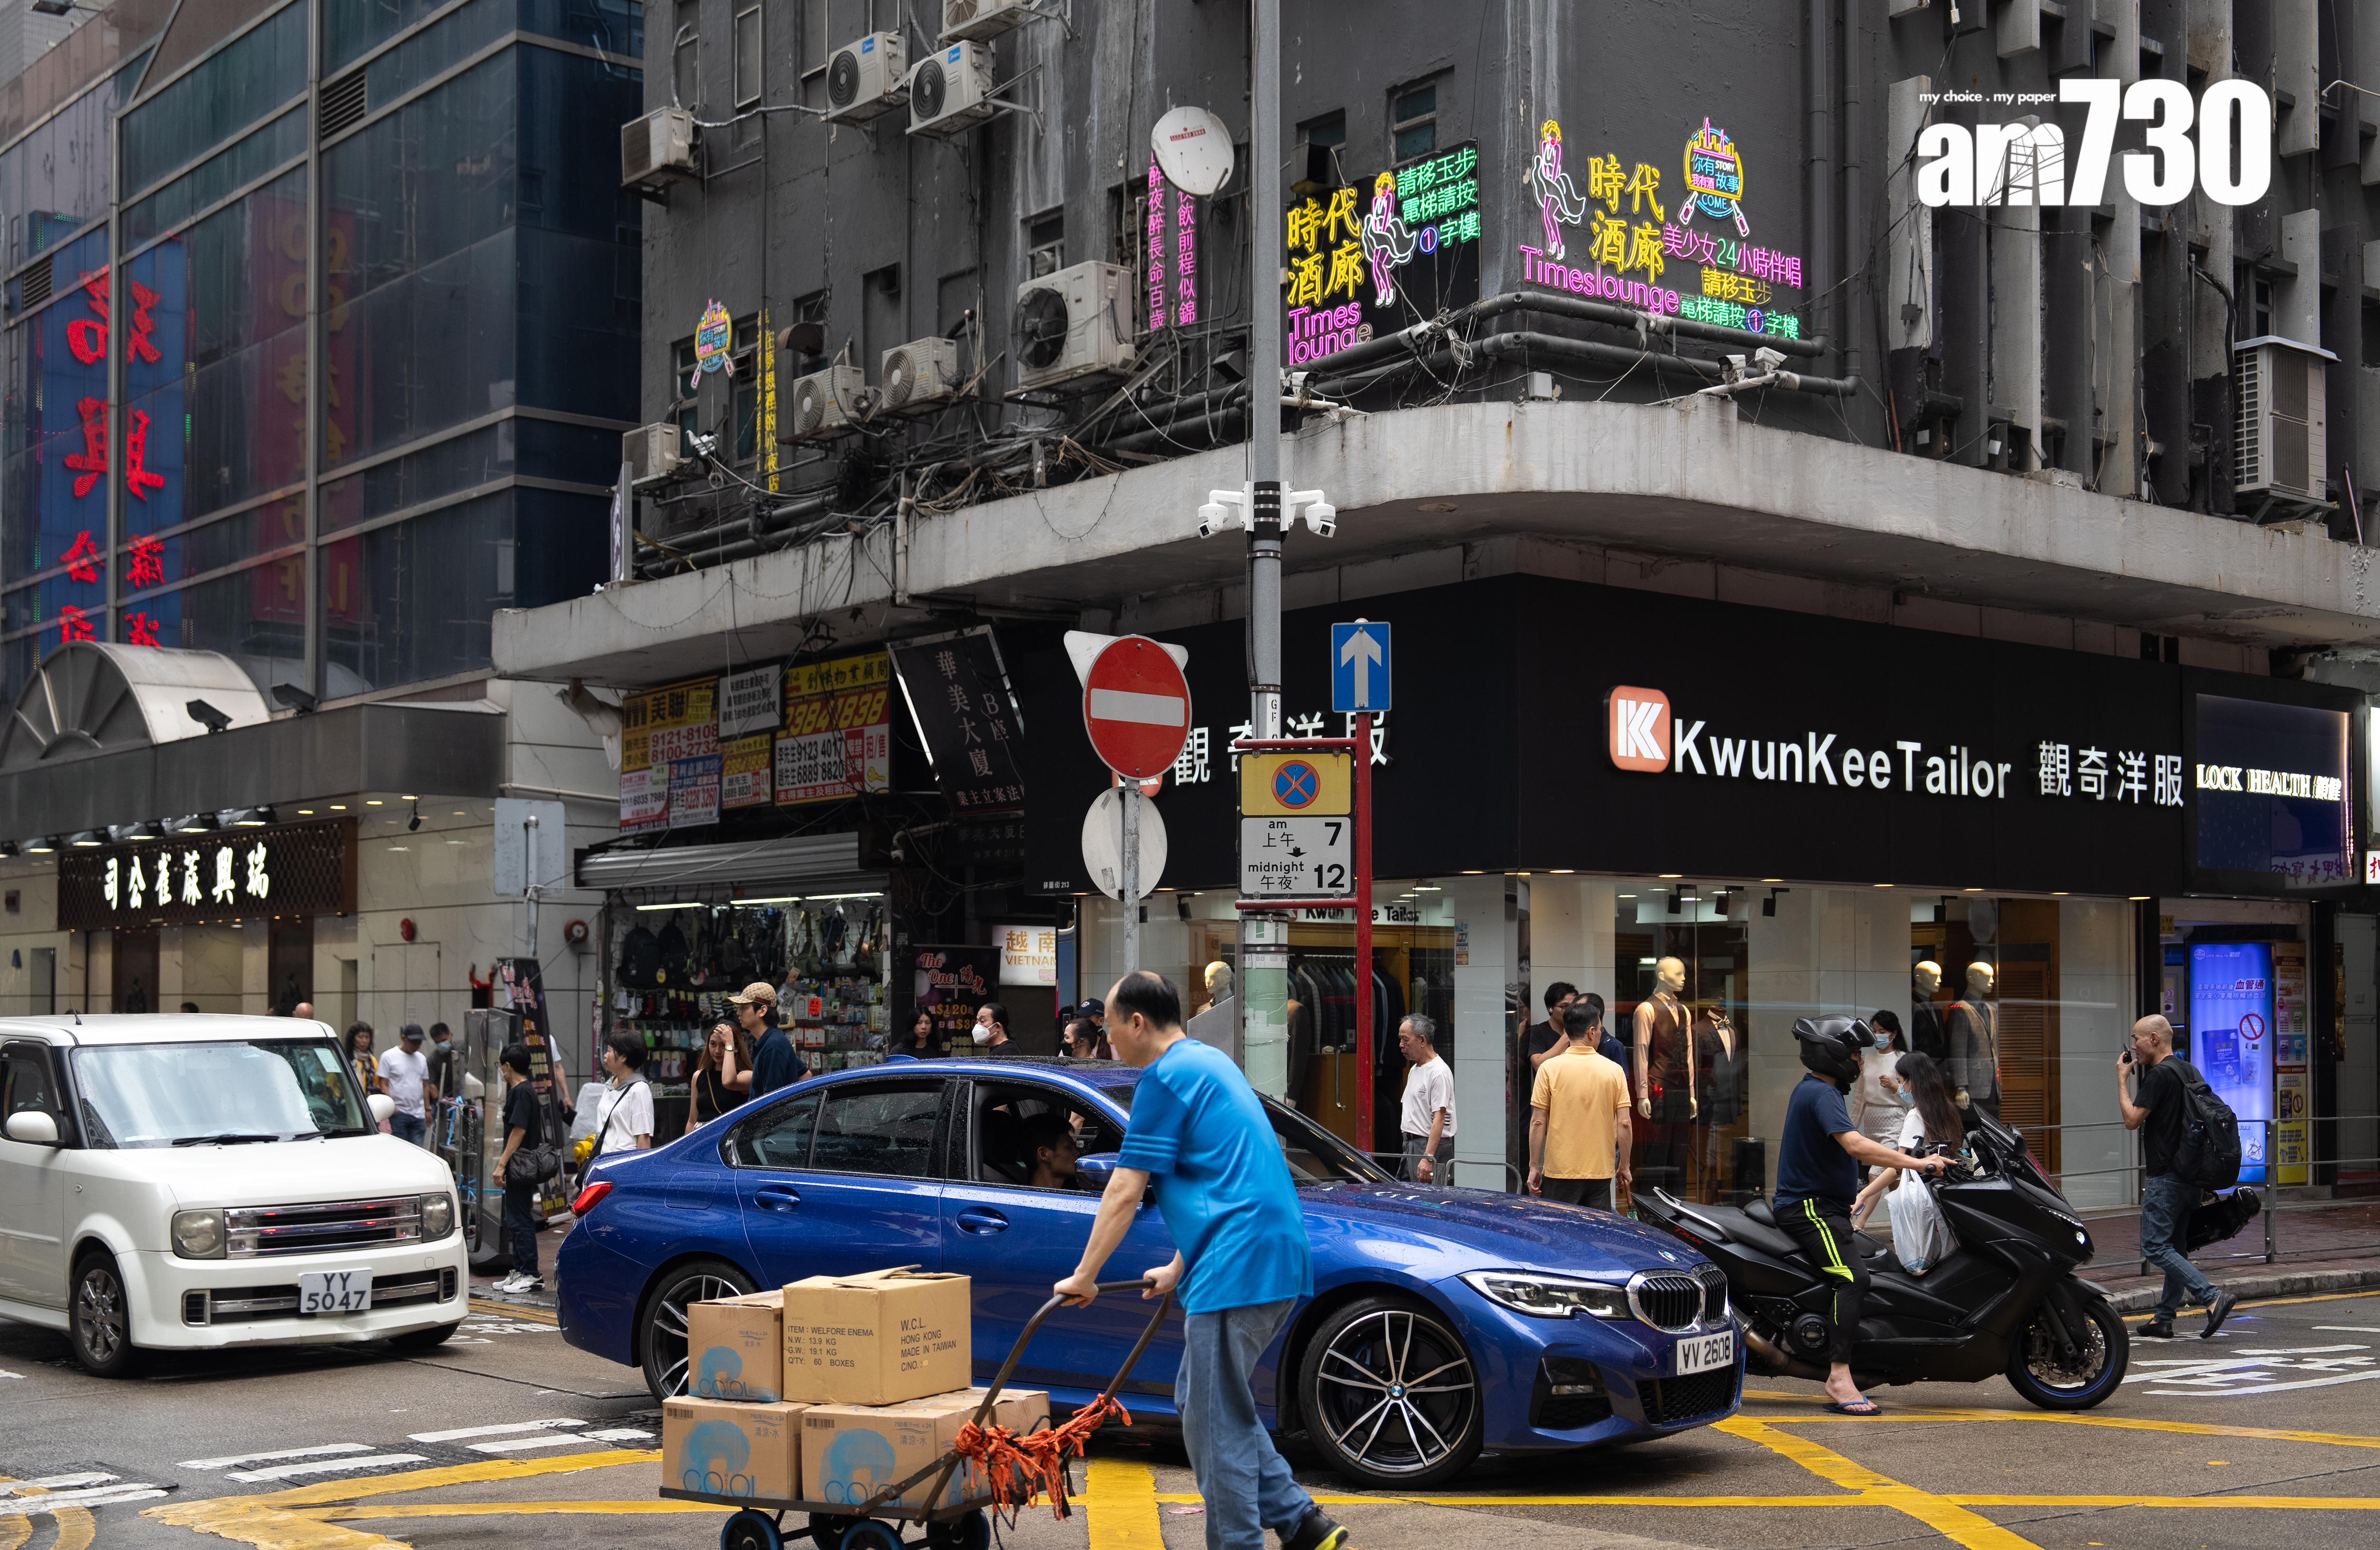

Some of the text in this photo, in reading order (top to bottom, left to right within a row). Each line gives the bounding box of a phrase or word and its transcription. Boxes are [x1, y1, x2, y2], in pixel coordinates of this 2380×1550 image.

[1397, 147, 1478, 199] 請移玉步
[1691, 153, 1735, 176] 你有 STORY
[1587, 152, 1665, 223] 時代
[1692, 171, 1739, 193] 我有酒 故事
[1402, 179, 1478, 224] 電梯請按
[1702, 194, 1727, 210] COME
[1288, 187, 1362, 253] 時代
[1590, 210, 1665, 285] 酒廊
[1288, 240, 1364, 307] 酒廊
[1519, 245, 1680, 317] Timeslounge
[1701, 267, 1773, 305] 請移玉步
[1289, 301, 1362, 341] Times
[1289, 323, 1373, 366] lounge
[704, 354, 721, 367] COME
[935, 650, 993, 777] 華美大廈
[652, 724, 718, 748] 9121-8108
[652, 739, 718, 763] 8100-2732
[797, 741, 818, 762] 9123
[821, 737, 843, 758] 4017
[797, 764, 818, 784] 6889
[821, 760, 843, 781] 8820
[2038, 740, 2185, 807] 觀奇洋服
[2196, 764, 2243, 791] LOCK
[2246, 769, 2311, 798] HEALTH
[956, 784, 1024, 806] 業主立案法
[1262, 832, 1295, 848] 上午
[1268, 820, 1342, 846] am 7
[1248, 861, 1345, 889] midnight 12
[1260, 874, 1293, 891] 午夜
[1384, 905, 1421, 922] Tailor
[1006, 930, 1056, 953] 越南
[920, 953, 944, 968] The
[928, 969, 954, 984] One
[959, 964, 987, 995] 陽光
[2235, 979, 2266, 991] 血管通
[323, 1272, 352, 1292] YY
[306, 1290, 367, 1312] 5047
[788, 1325, 874, 1337] ITEM WELFORE ENEMA
[901, 1317, 926, 1332] W.C.L.
[809, 1337, 823, 1345] 13.9
[901, 1329, 942, 1345] HONG KONG
[788, 1347, 806, 1355] G.W.:
[826, 1348, 837, 1356] KG
[901, 1339, 957, 1359] MADE IN TAIWAN
[1682, 1335, 1731, 1370] VV 2608
[813, 1358, 822, 1366] 60
[830, 1359, 855, 1368] BOXES
